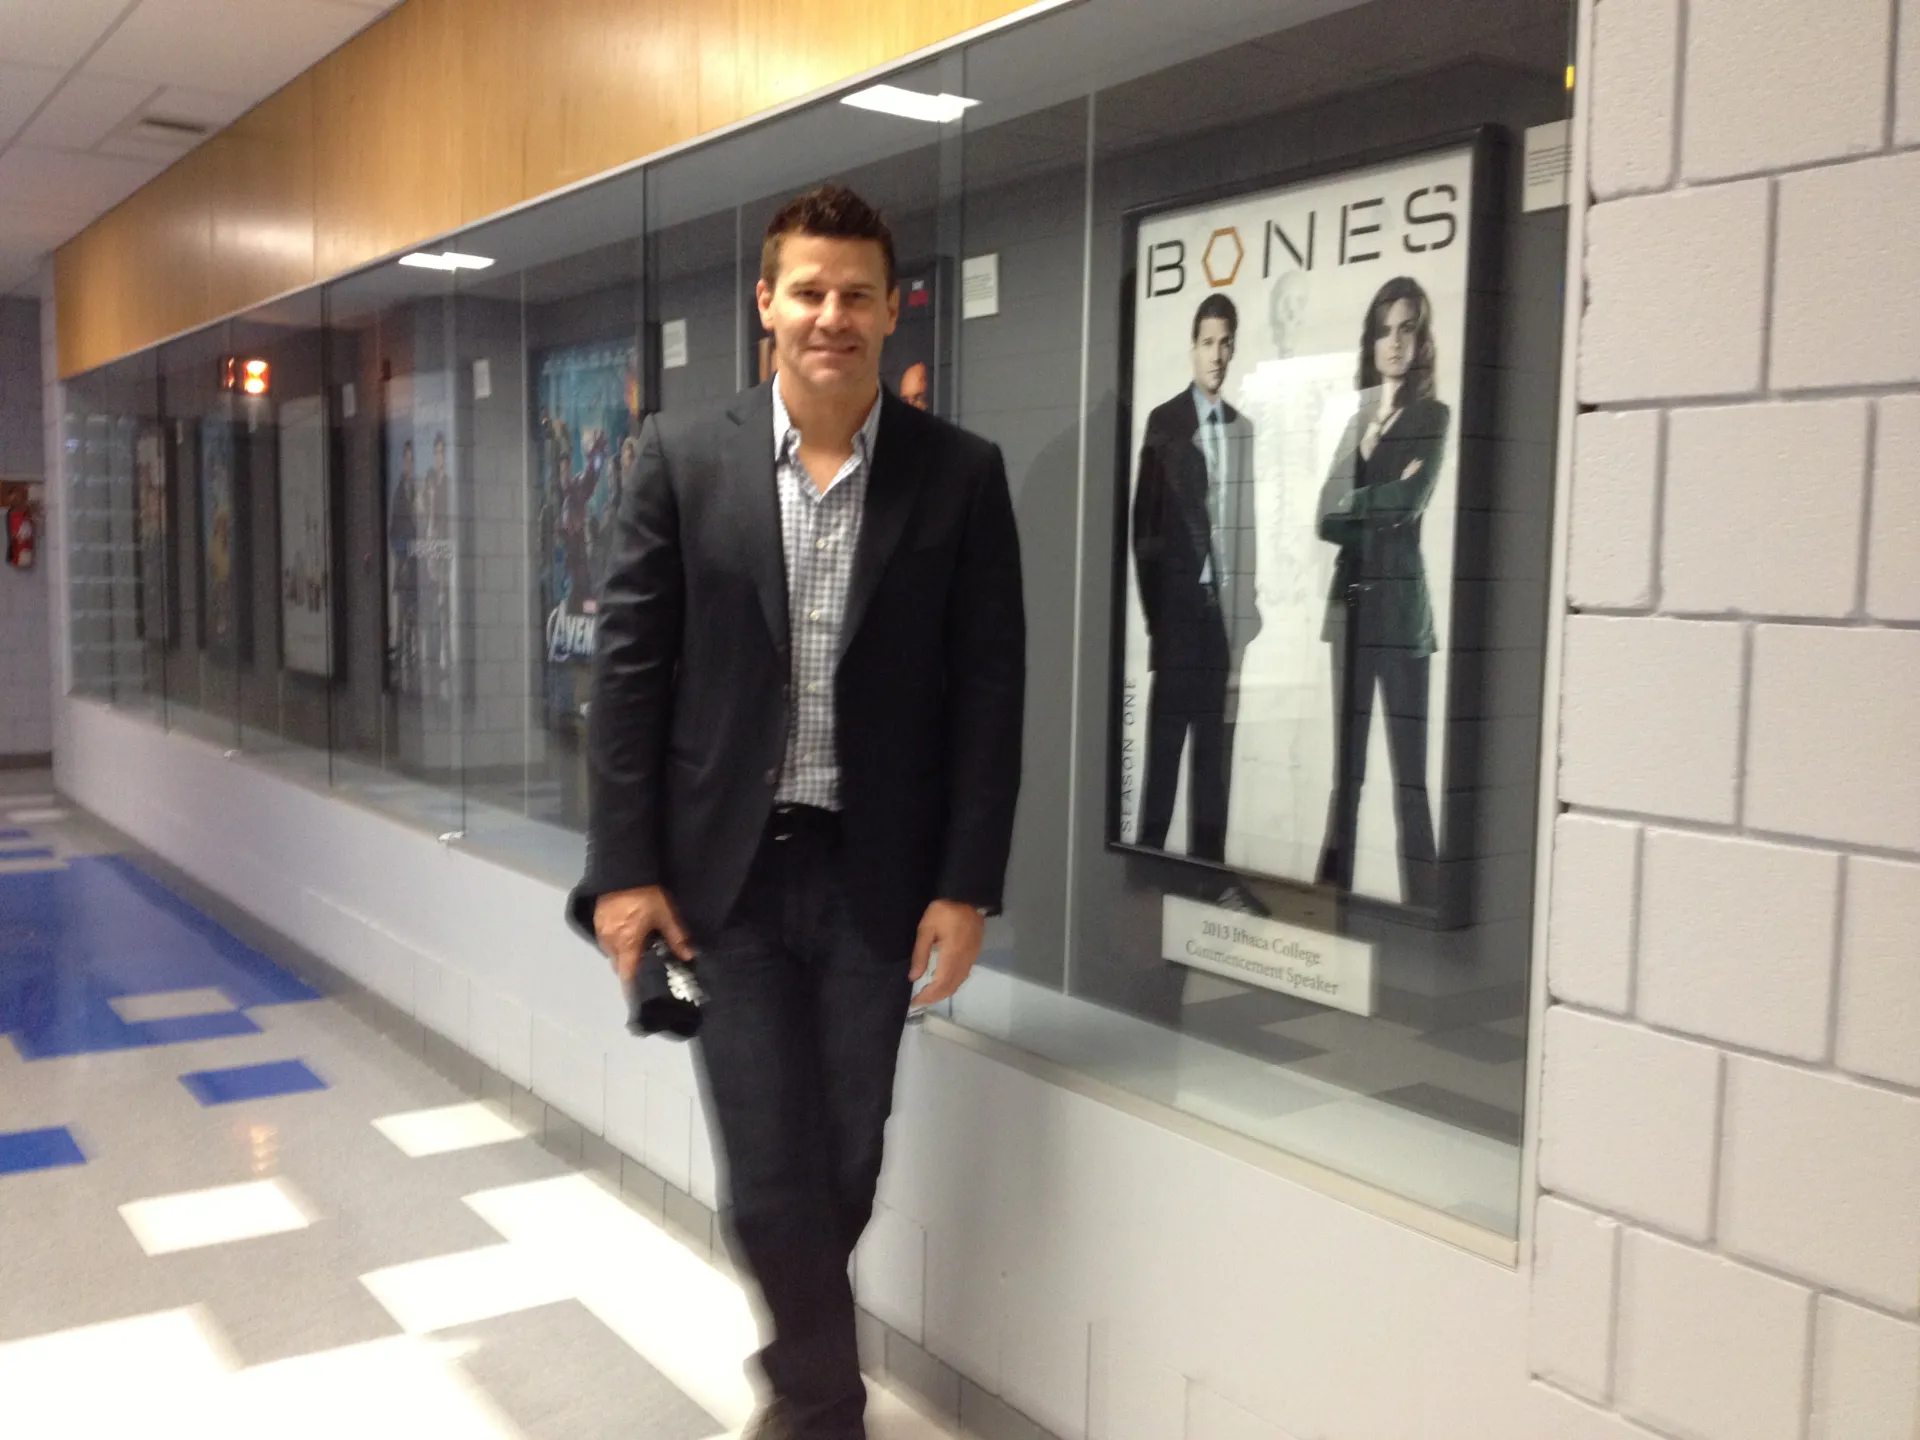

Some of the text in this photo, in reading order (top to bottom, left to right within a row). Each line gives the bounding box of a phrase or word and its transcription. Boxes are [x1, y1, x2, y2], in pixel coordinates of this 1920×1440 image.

[1147, 183, 1457, 298] BONES
[1121, 678, 1136, 832] SEASON ONE
[1186, 940, 1339, 995] Commencement Speaker
[1202, 920, 1321, 966] 2013 Ithaca College
